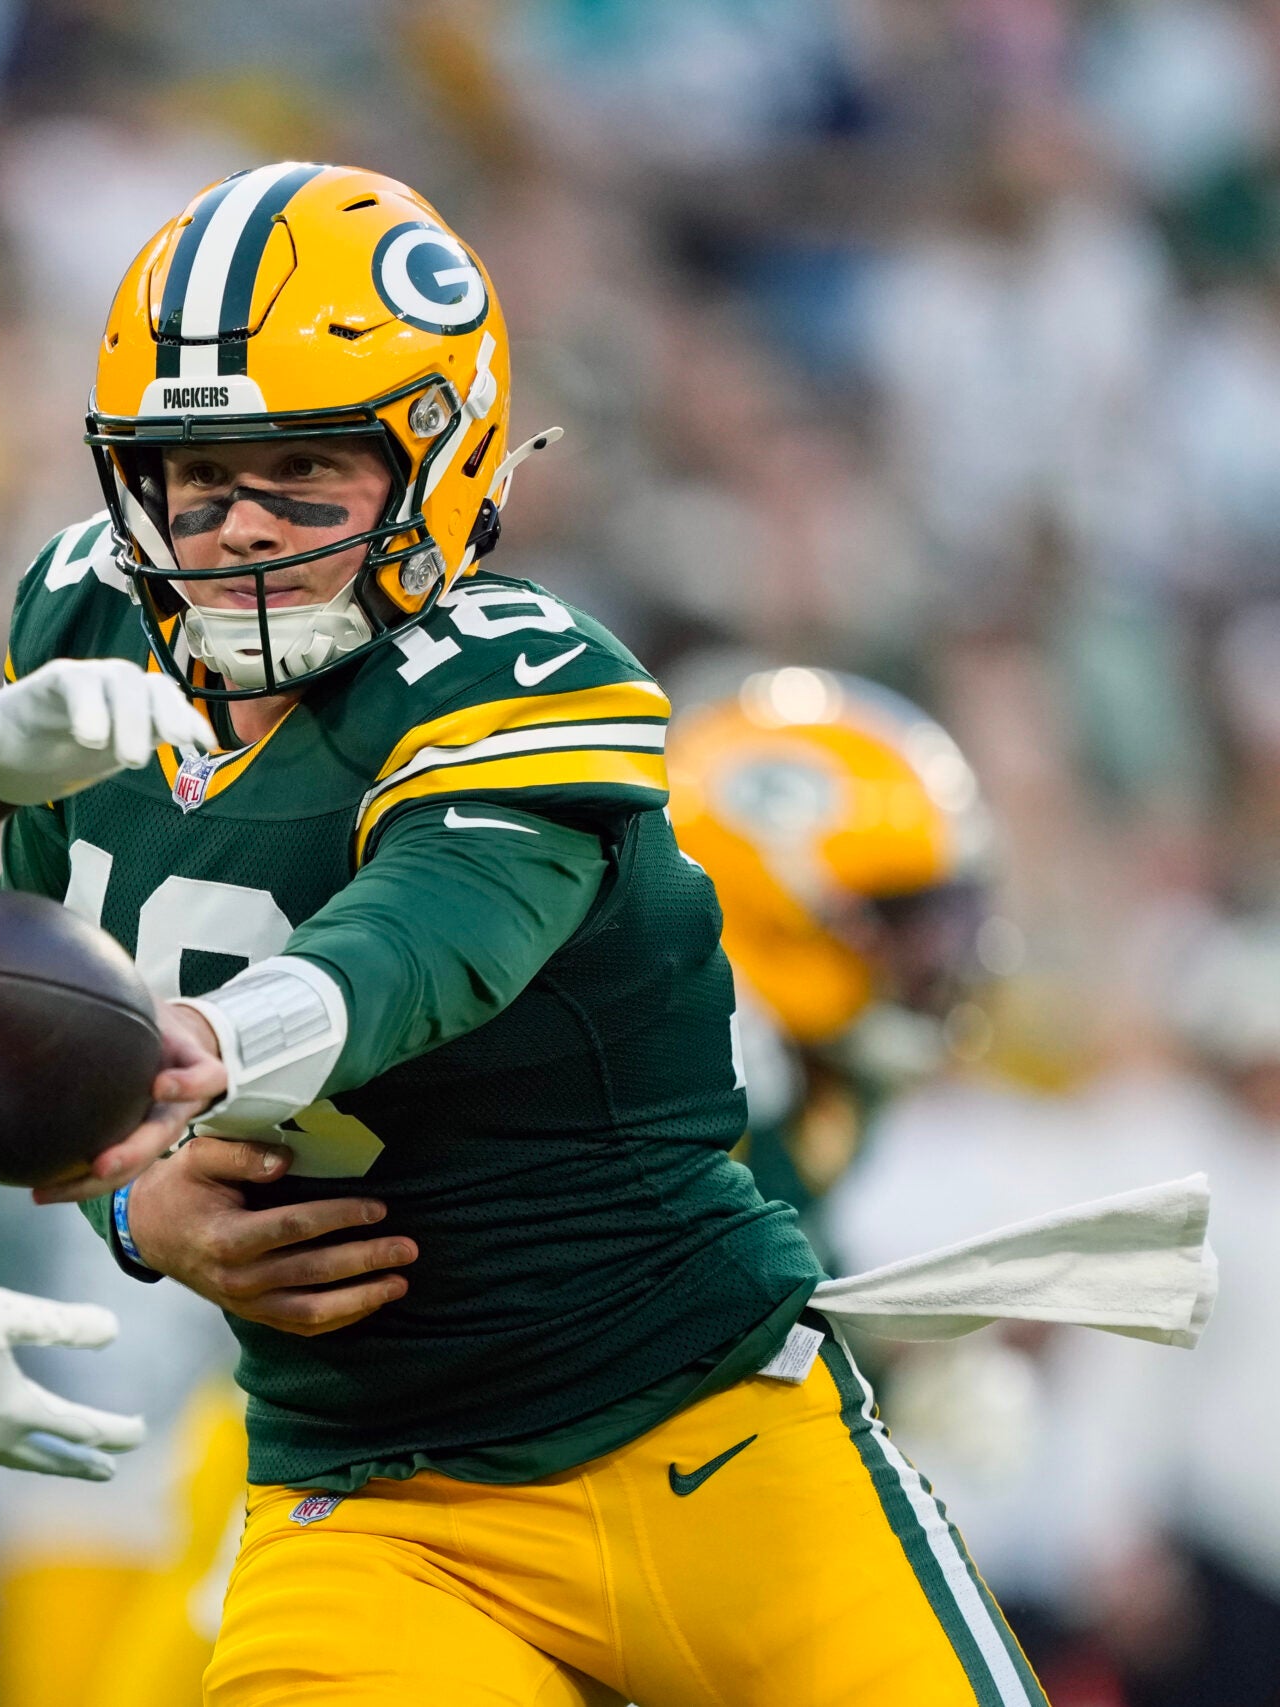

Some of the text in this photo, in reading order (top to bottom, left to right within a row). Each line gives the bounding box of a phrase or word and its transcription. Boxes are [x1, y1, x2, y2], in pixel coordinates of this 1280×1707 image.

[381, 229, 486, 326] G
[163, 386, 230, 409] PACKERS
[177, 776, 200, 803] NFL
[297, 1502, 329, 1517] NFL
